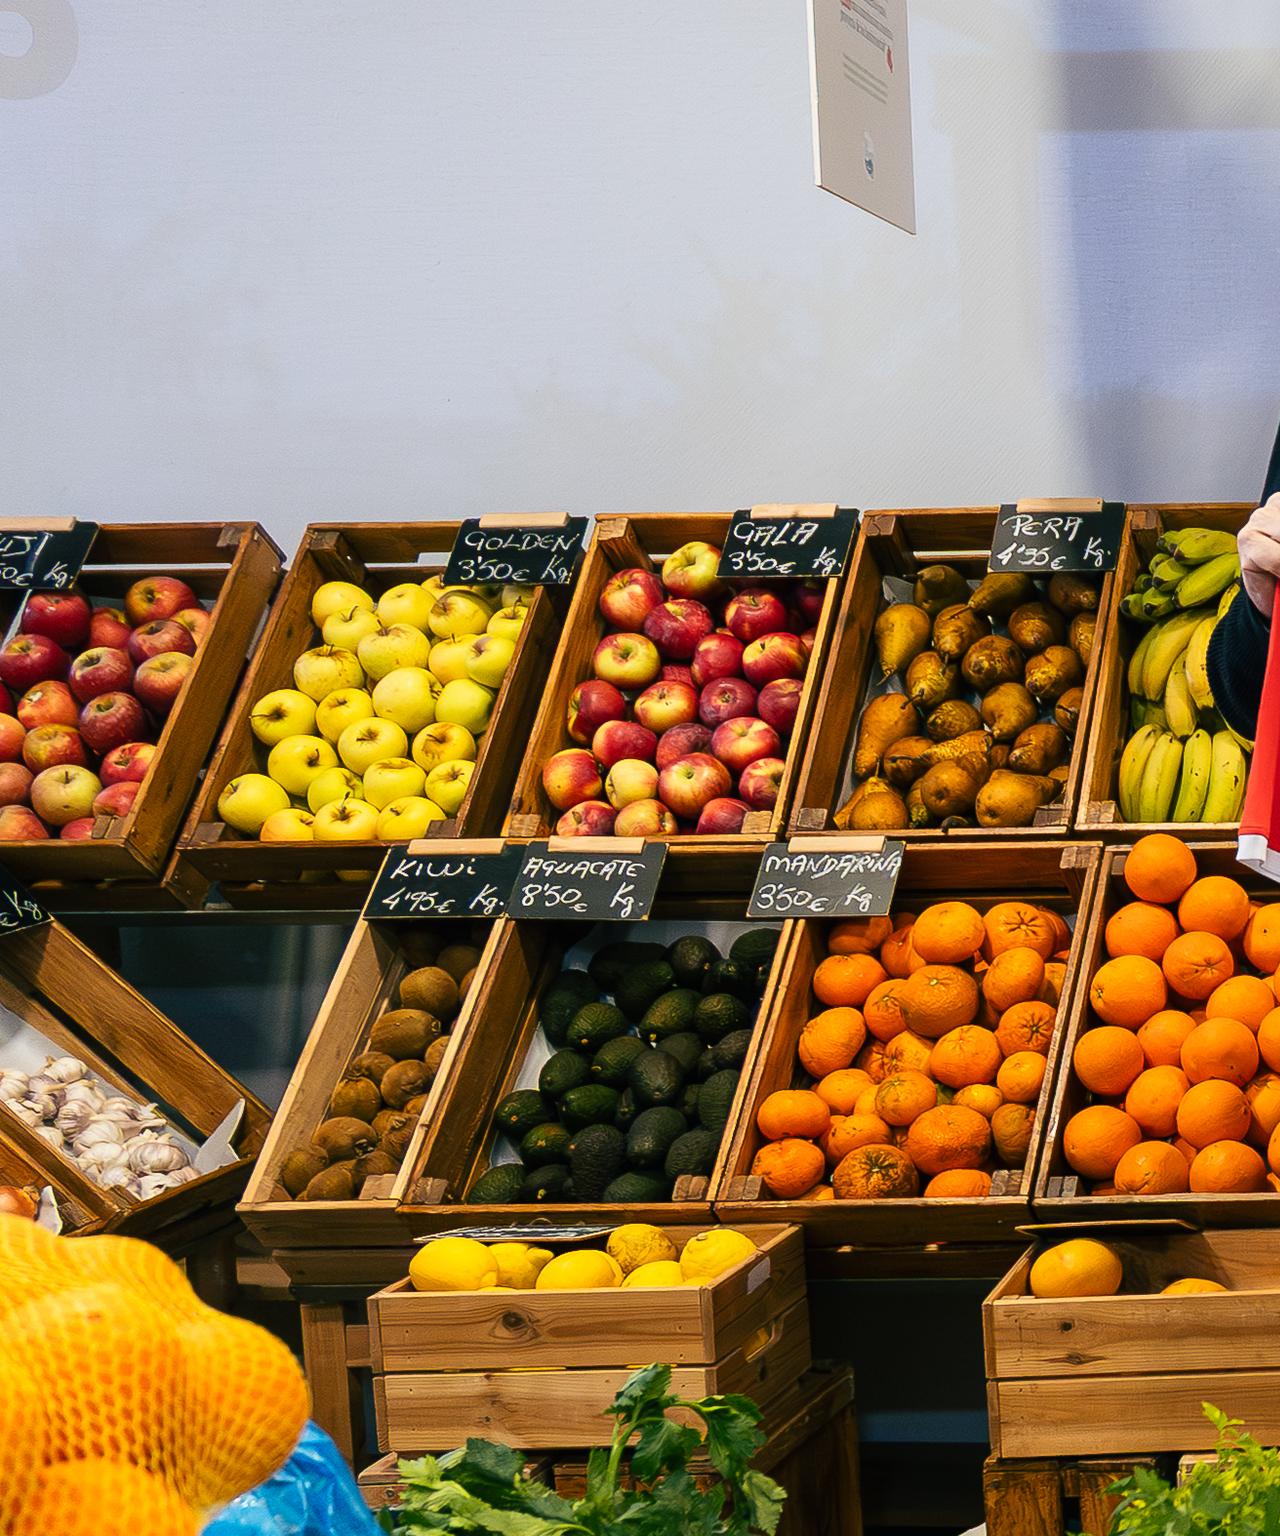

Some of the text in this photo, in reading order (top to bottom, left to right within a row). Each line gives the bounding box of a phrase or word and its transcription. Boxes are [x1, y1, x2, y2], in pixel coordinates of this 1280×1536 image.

[733, 519, 819, 546] GALA
[1002, 514, 1083, 539] PERA
[0, 532, 53, 557] UJI
[464, 531, 581, 551] GOLDEN
[0, 562, 34, 586] 0€
[522, 856, 646, 881] AGUACATE
[382, 886, 456, 914] 4'95€
[521, 883, 588, 913] 8'50€
[756, 883, 830, 912] 3'50€
